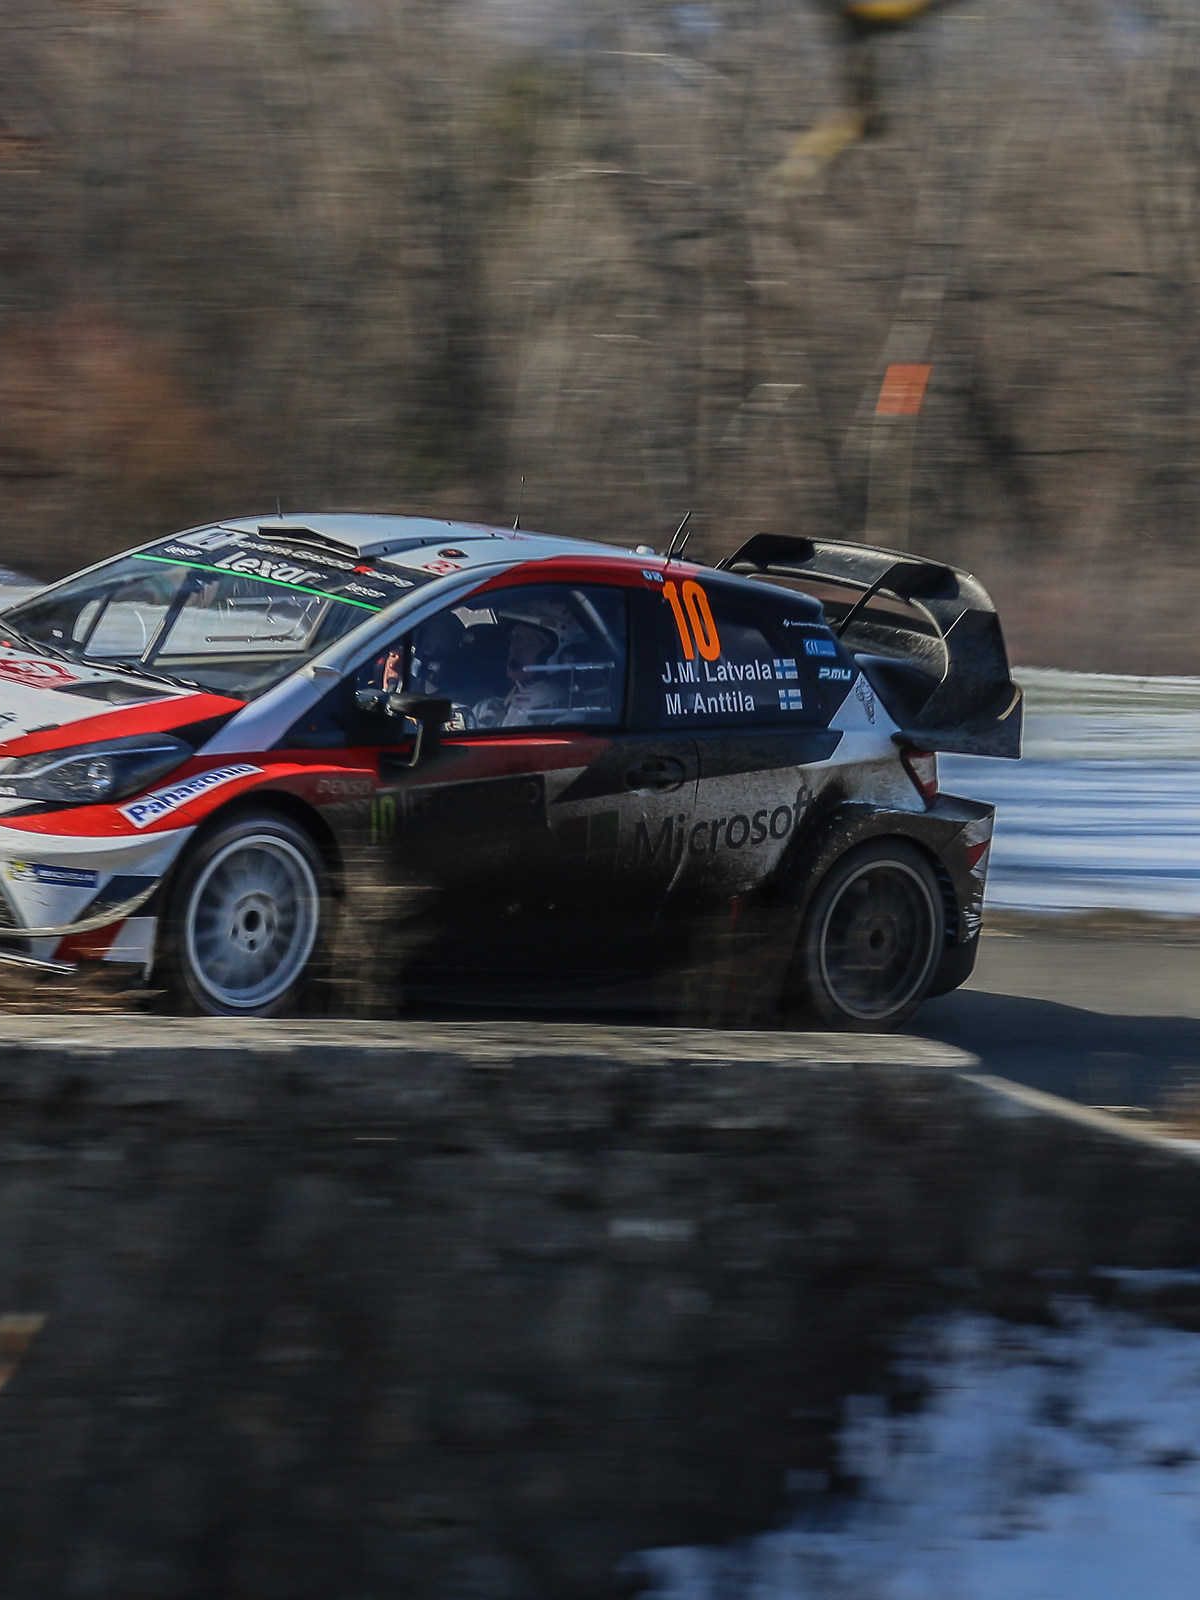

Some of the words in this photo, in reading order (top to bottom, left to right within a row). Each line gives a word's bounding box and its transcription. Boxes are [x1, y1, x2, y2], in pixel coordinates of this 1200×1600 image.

[214, 550, 326, 585] Lexar
[663, 580, 721, 661] 10
[661, 662, 700, 683] J.M.
[704, 659, 772, 682] Latvala
[665, 693, 688, 715] M.
[694, 691, 755, 714] Anttila
[126, 764, 256, 823] Panasonic
[633, 784, 815, 864] Microsoft
